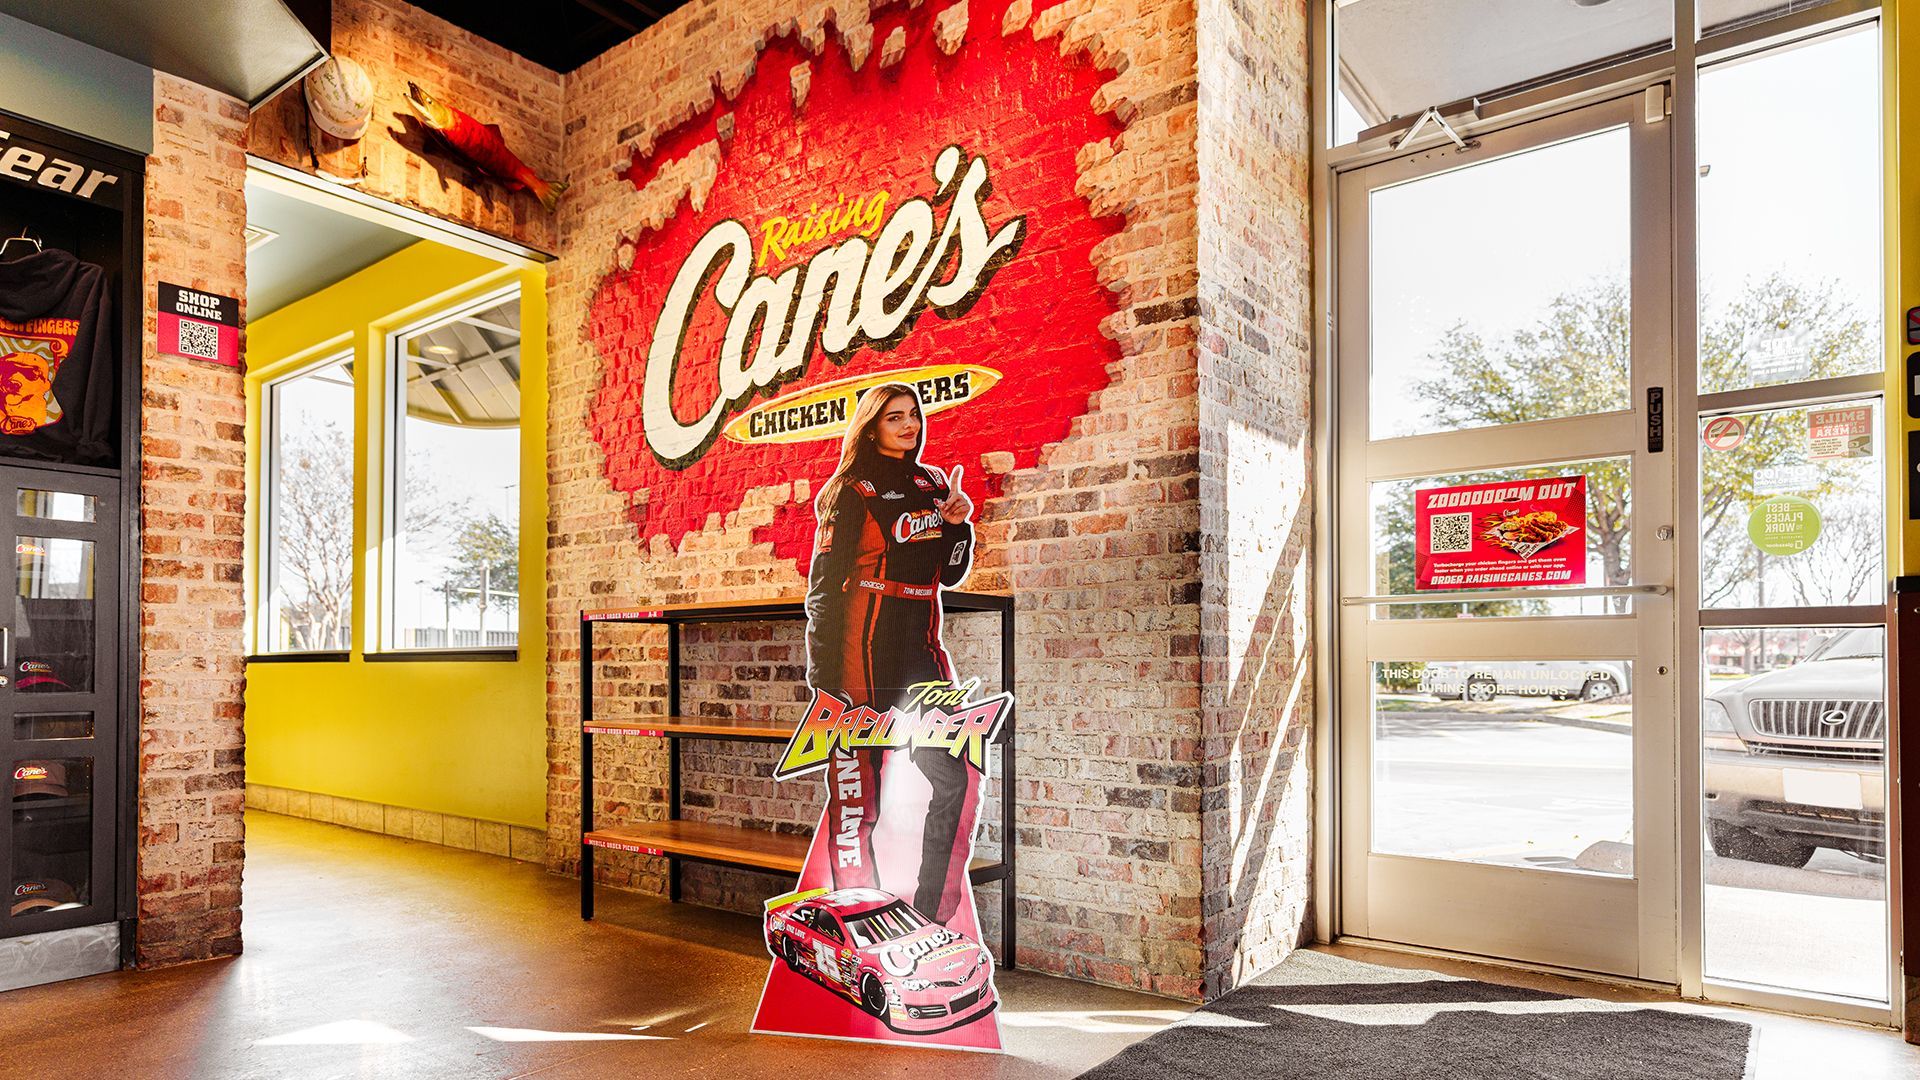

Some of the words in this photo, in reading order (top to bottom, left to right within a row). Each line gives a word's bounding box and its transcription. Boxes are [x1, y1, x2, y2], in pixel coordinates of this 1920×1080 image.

[0, 130, 118, 198] ear
[757, 191, 890, 267] Raising
[175, 302, 222, 321] ONLINE
[178, 289, 220, 309] SHOP
[644, 146, 1023, 463] Cane's
[26, 319, 80, 336] FINGERS
[749, 398, 846, 437] CHICKEN
[1650, 392, 1661, 437] PUSH
[1538, 482, 1577, 500] OUT
[1431, 570, 1572, 585] ORDER.RAISINGCANES.COM
[1382, 669, 1409, 679] THIS
[1412, 669, 1448, 679] DOOR
[1454, 670, 1471, 679] TO
[1474, 670, 1526, 681] REMAIN
[1531, 670, 1611, 681] UNLOCKED
[1417, 683, 1465, 693] DURING
[1469, 684, 1515, 695] STORE
[1518, 685, 1568, 695] HOURS
[904, 680, 976, 712] Toni
[780, 688, 1005, 772] BREIDINGER
[14, 766, 48, 780] Cane's
[836, 806, 864, 868] LOVE
[879, 928, 964, 977] Cane's
